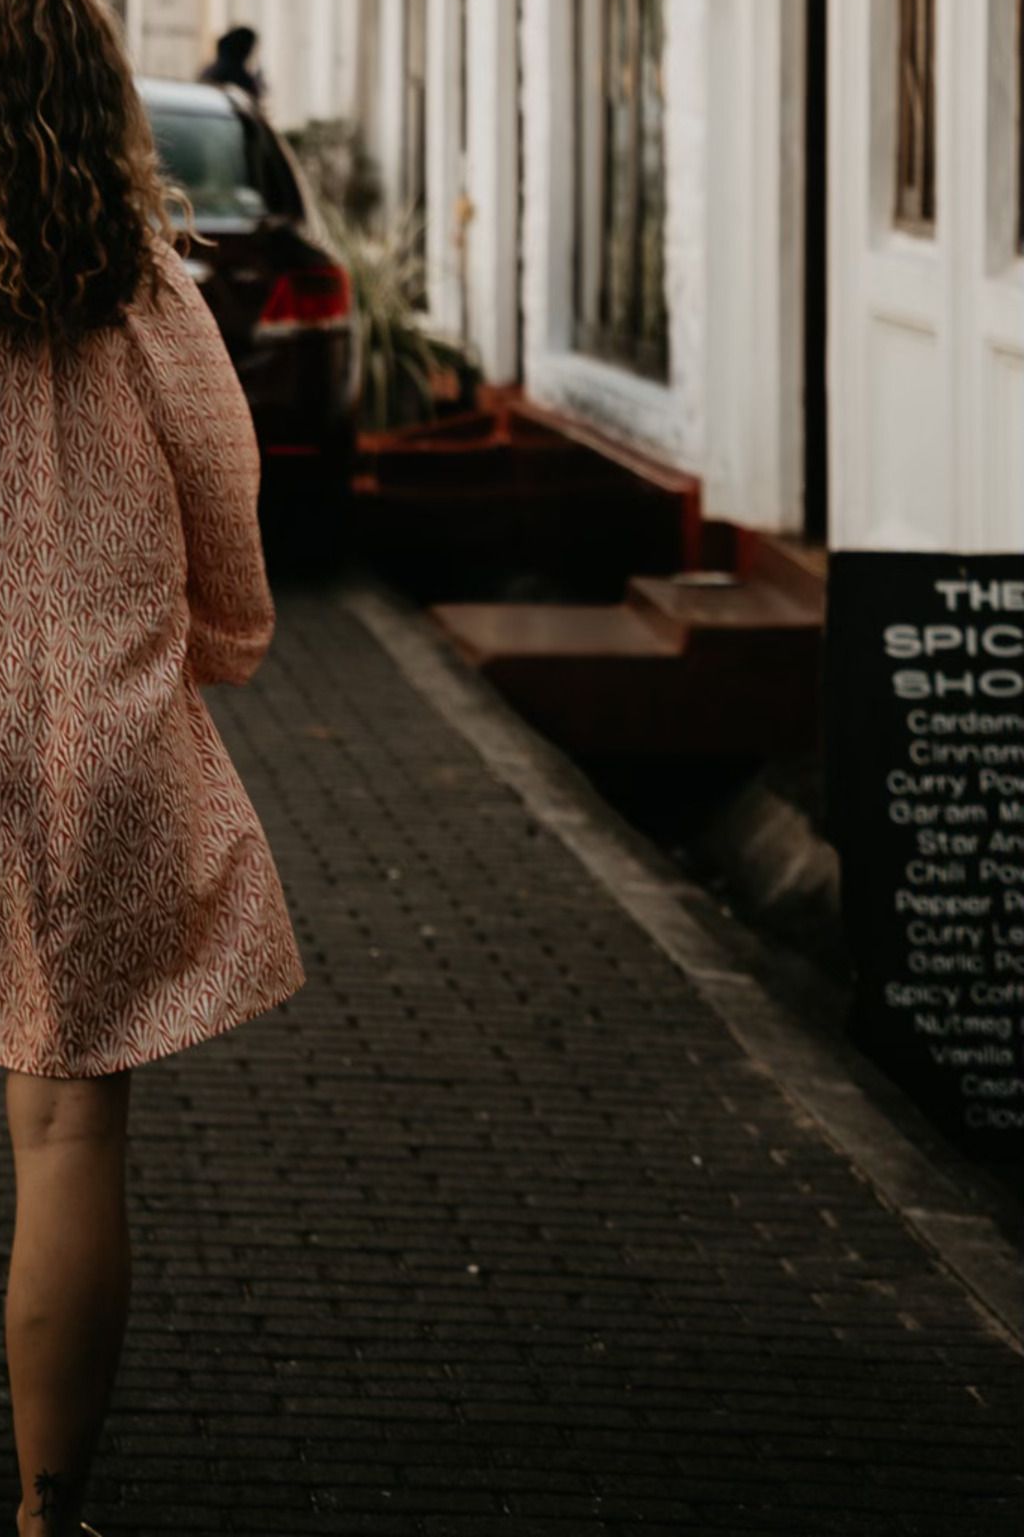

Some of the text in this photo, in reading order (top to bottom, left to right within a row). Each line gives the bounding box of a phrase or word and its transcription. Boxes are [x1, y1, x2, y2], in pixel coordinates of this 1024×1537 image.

[934, 580, 1024, 611] THE
[883, 624, 1024, 659] SPIC
[892, 669, 1024, 699] SHO
[886, 769, 967, 799] Curry
[889, 799, 987, 825] Garam
[916, 829, 979, 855] Star
[895, 889, 991, 916] Pepper
[906, 920, 983, 949] Curry
[885, 982, 959, 1007] Spicy
[914, 1013, 1013, 1040] Nutmeg
[931, 1045, 1014, 1065] Vanilla
